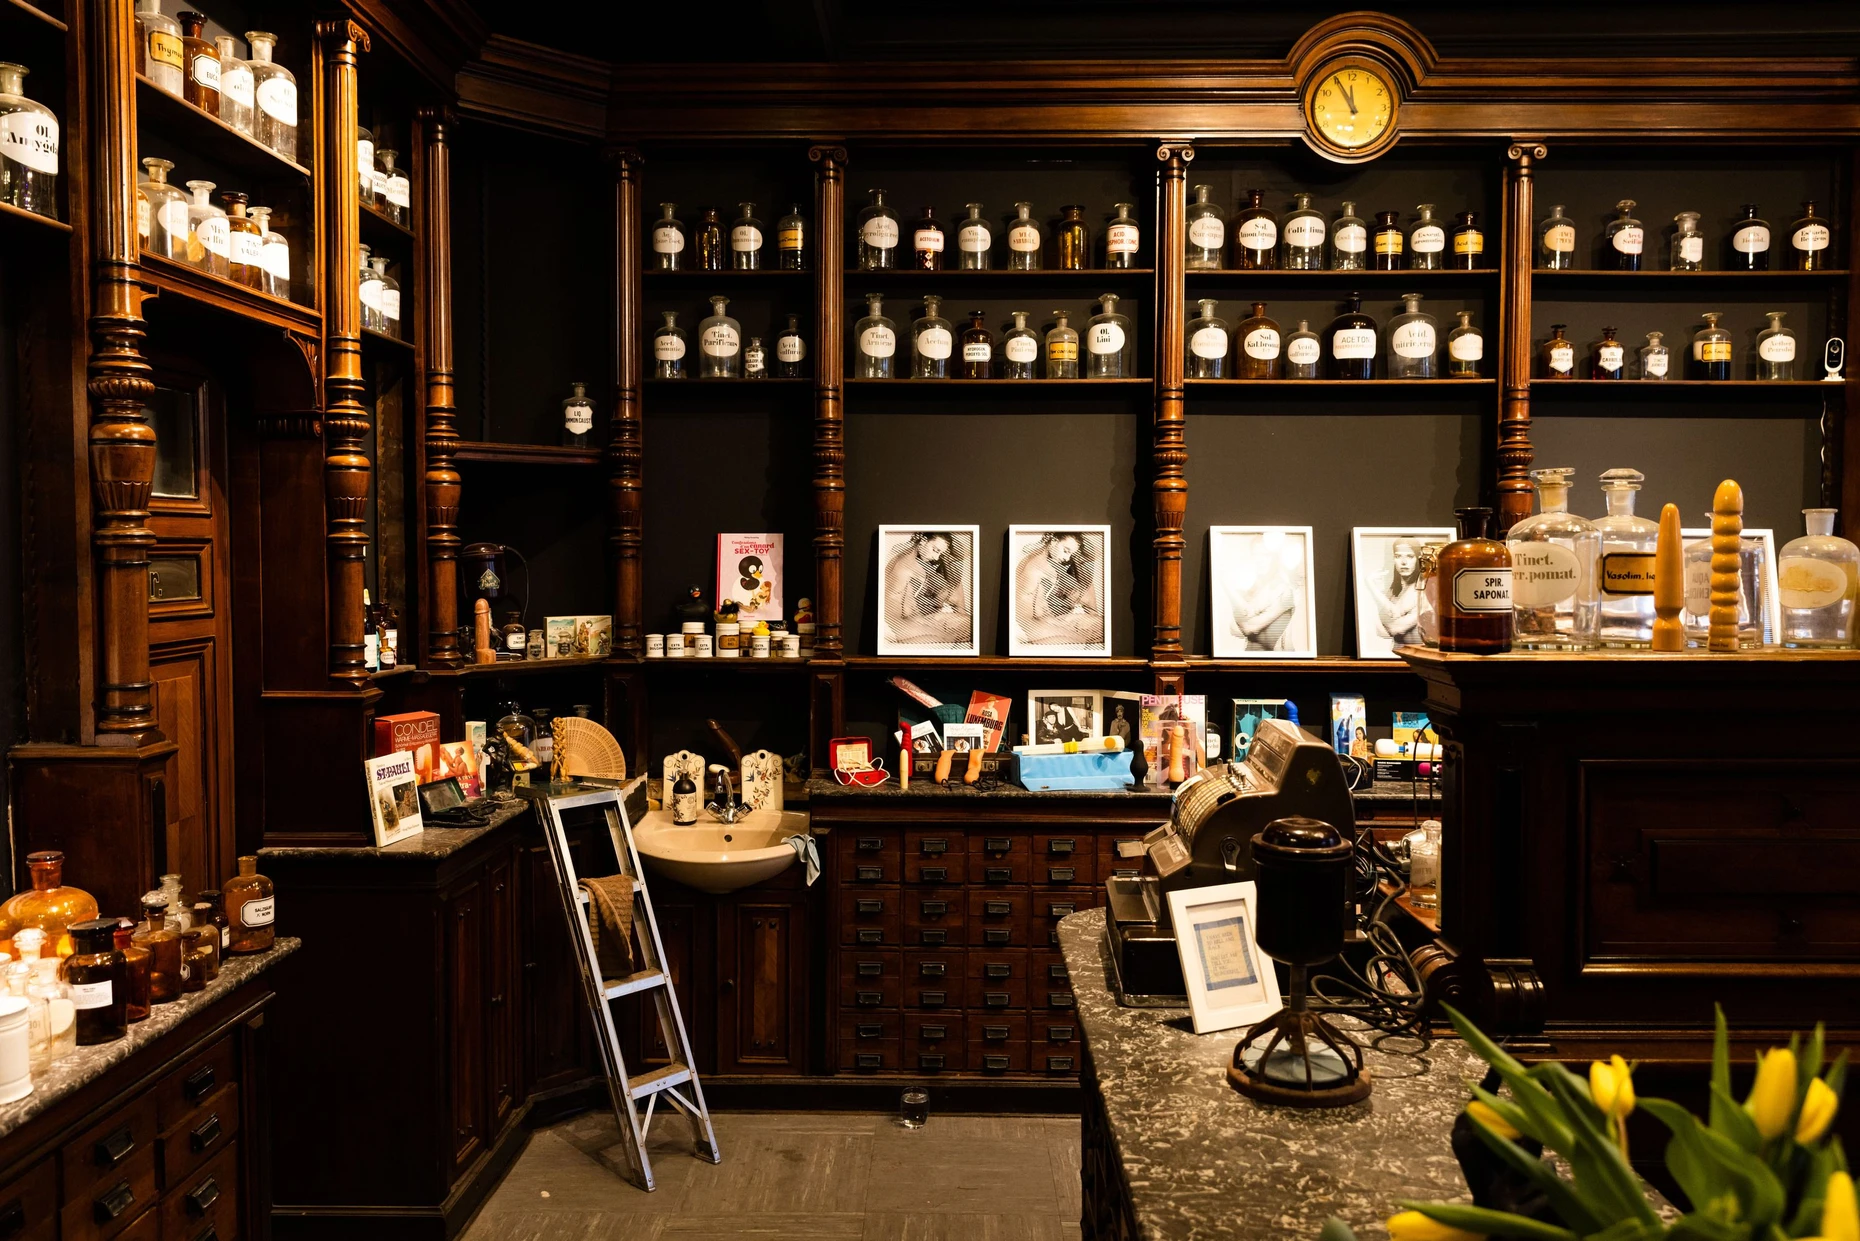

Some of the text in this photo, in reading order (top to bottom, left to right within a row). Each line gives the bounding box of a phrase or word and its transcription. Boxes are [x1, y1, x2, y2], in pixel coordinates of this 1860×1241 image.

[1348, 73, 1357, 81] 12
[36, 125, 51, 138] Ol.
[1515, 553, 1553, 566] Tinct.
[1485, 578, 1504, 587] SPIR.
[1474, 590, 1510, 600] SAPONAT.
[1141, 695, 1204, 705] PENTUSE
[982, 710, 992, 718] ROSA
[966, 713, 1004, 731] LUXEMBURG
[394, 719, 438, 737] CONDEL
